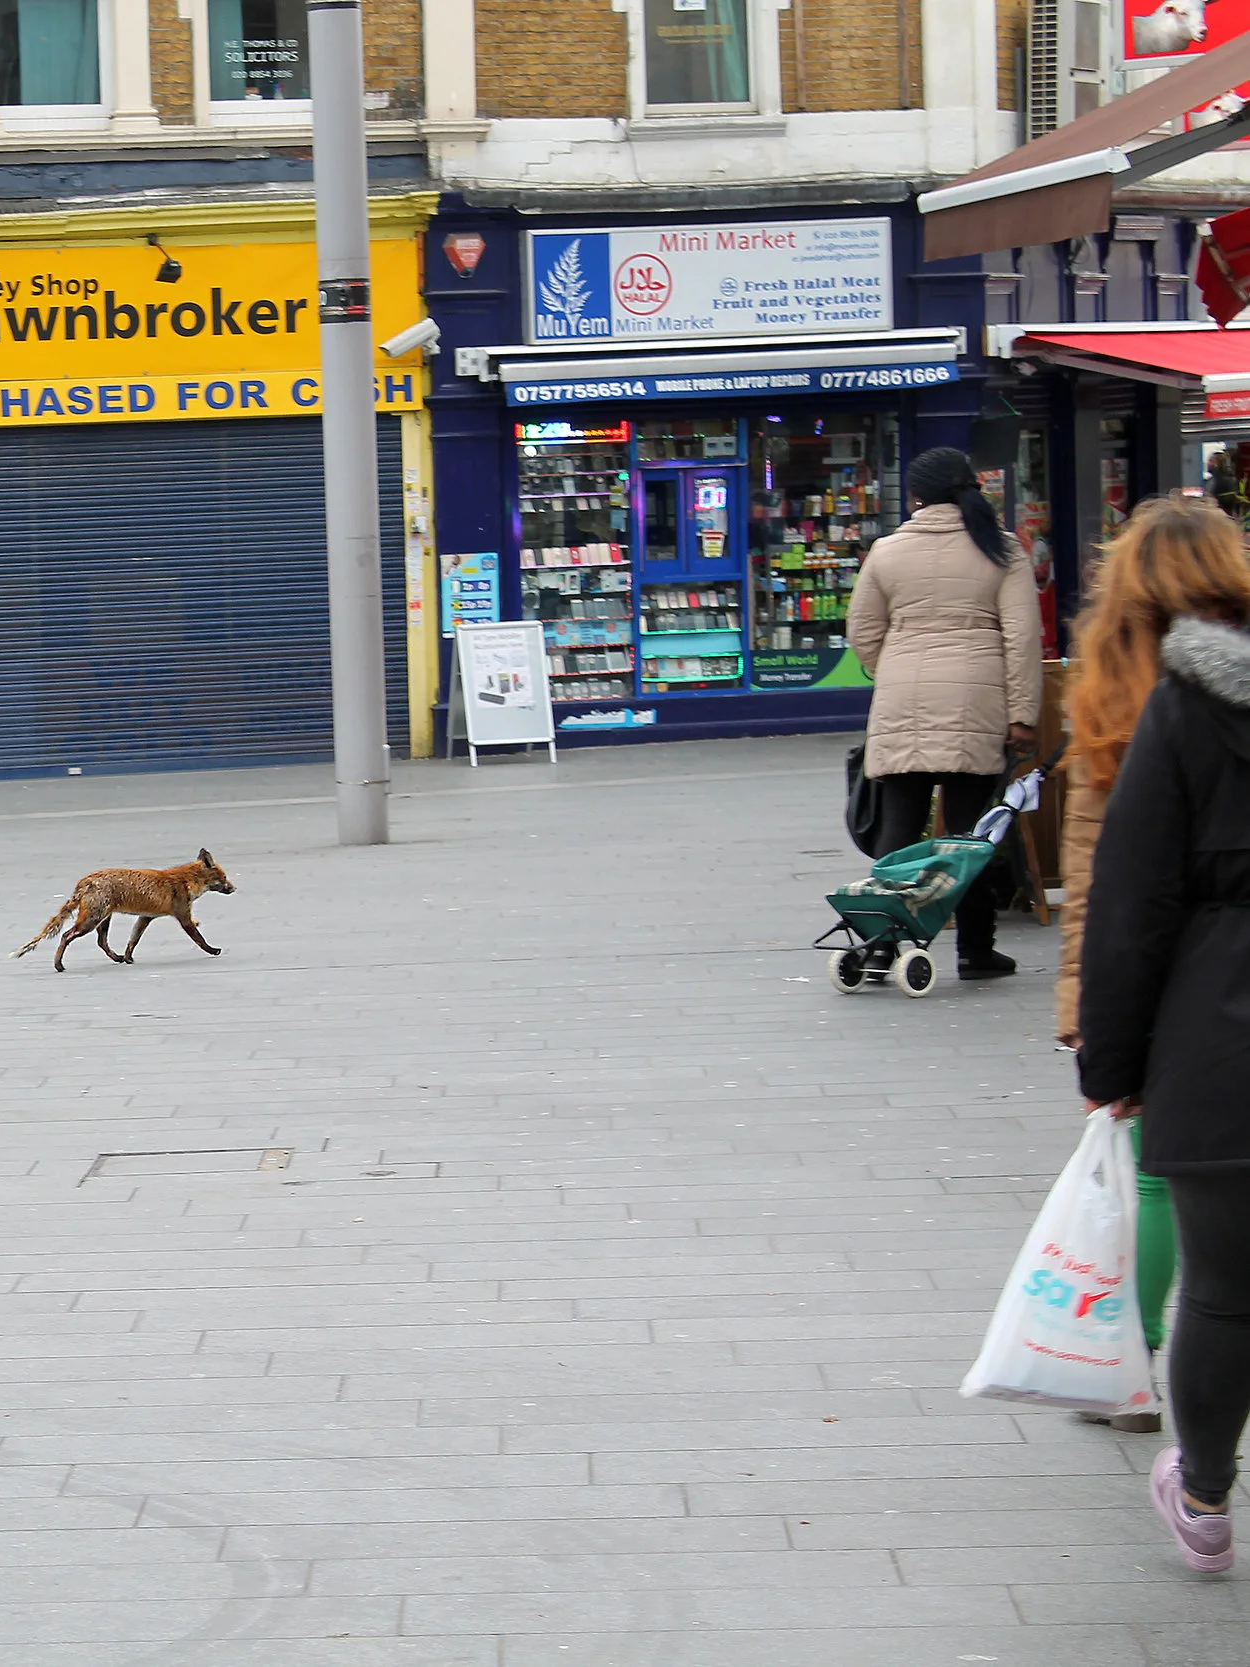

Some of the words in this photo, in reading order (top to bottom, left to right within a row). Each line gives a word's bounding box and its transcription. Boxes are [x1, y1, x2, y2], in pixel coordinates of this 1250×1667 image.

[242, 39, 276, 48] THOMAS
[224, 51, 299, 63] SOLICITORS
[658, 232, 709, 252] Mini
[715, 229, 796, 250] Market
[31, 273, 99, 300] Shop
[620, 266, 667, 291] حلال
[744, 279, 788, 292] Fresh
[793, 277, 836, 290] Halal
[842, 275, 881, 287] Meat
[622, 292, 664, 304] HALAL
[712, 297, 753, 310] Fruit
[759, 295, 789, 308] and
[793, 292, 882, 308] Vegetables
[536, 312, 610, 337] MuYem
[615, 318, 654, 333] Mini
[656, 315, 714, 331] Market
[755, 312, 807, 325] Money
[813, 306, 882, 321] Transfer
[177, 379, 269, 411] FOR
[291, 373, 413, 407] CH
[514, 381, 647, 402] 07577556514
[655, 379, 693, 392] MOBILE
[693, 378, 725, 391] PHONE
[725, 379, 734, 390] &
[733, 375, 769, 389] LAPTOP
[769, 373, 811, 387] REPAIRS
[819, 366, 950, 390] 07774861666
[753, 655, 784, 666] Small
[785, 654, 818, 666] World
